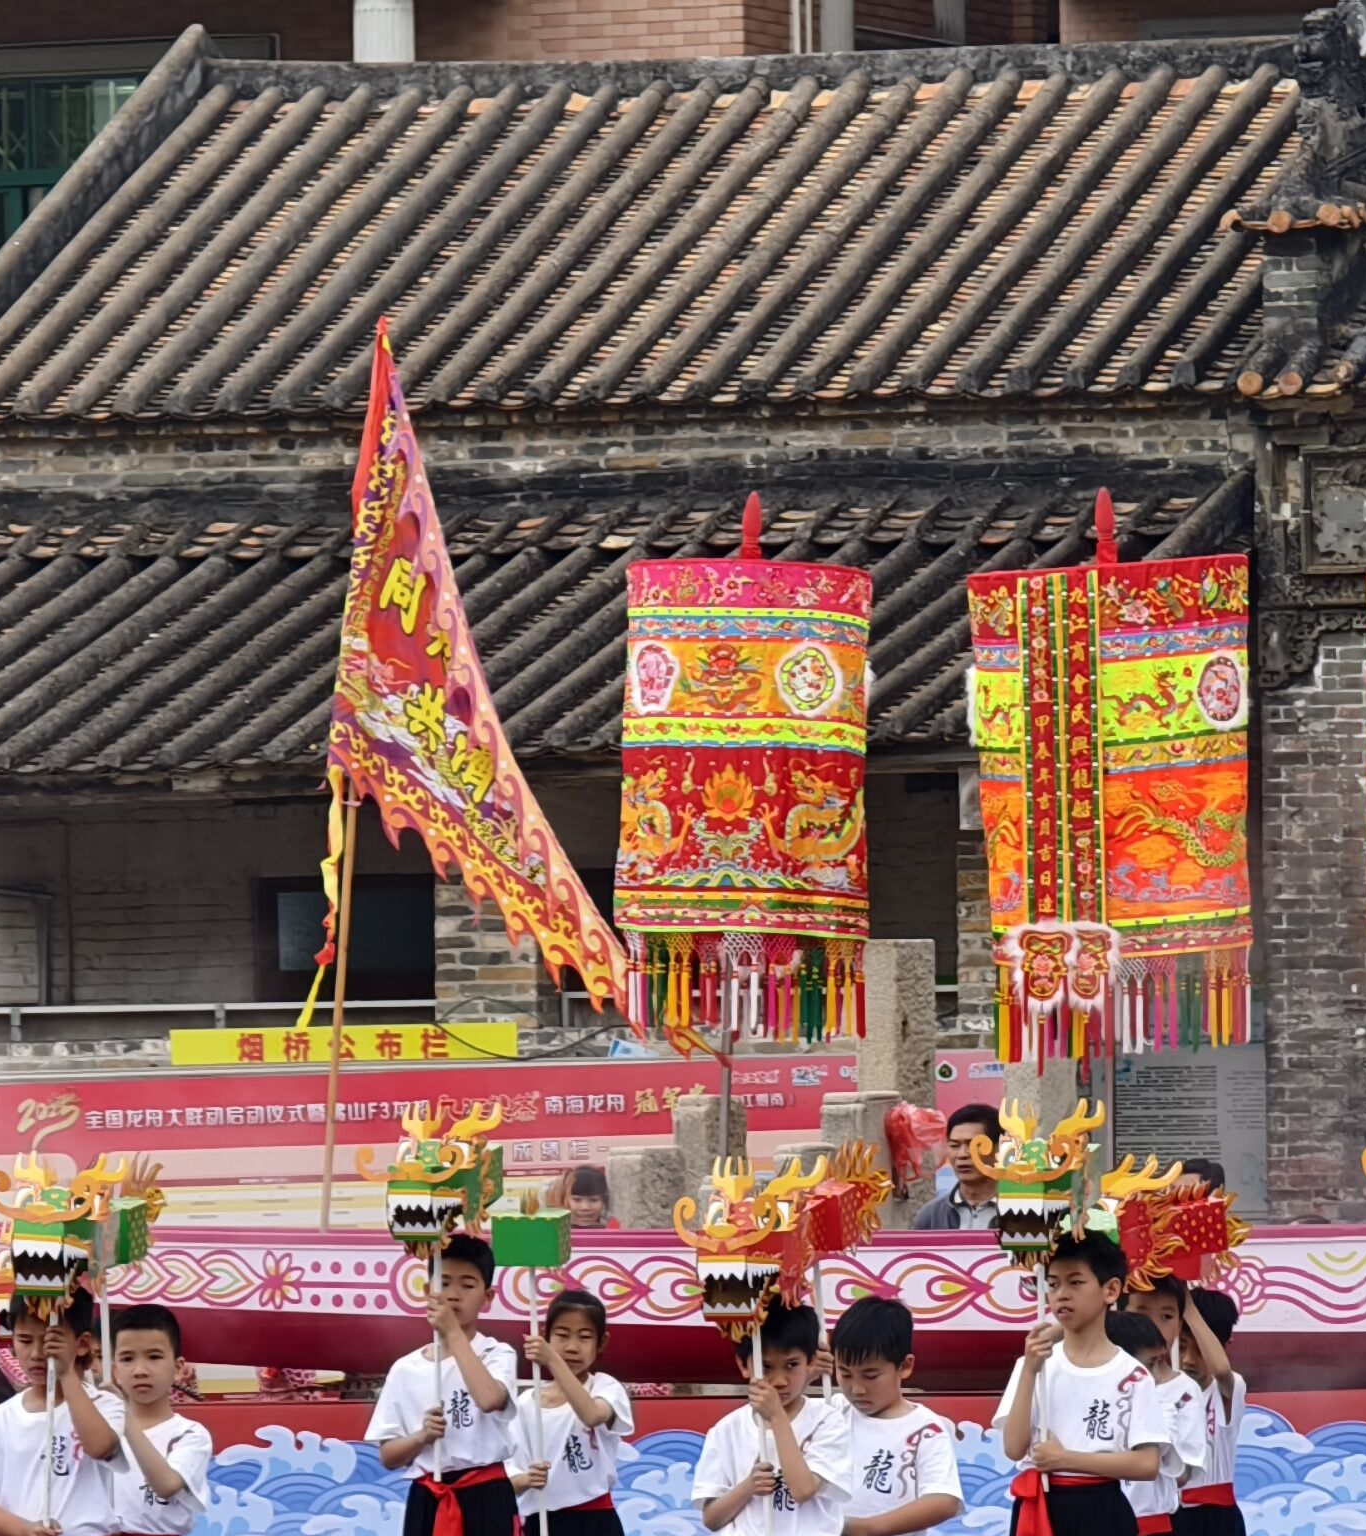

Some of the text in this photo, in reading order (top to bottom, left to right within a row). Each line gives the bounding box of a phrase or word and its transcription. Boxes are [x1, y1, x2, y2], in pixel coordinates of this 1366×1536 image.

[447, 1389, 474, 1429] 龍
[1082, 1398, 1114, 1442] 龍
[561, 1434, 593, 1474] 龍
[861, 1448, 893, 1494] 龍
